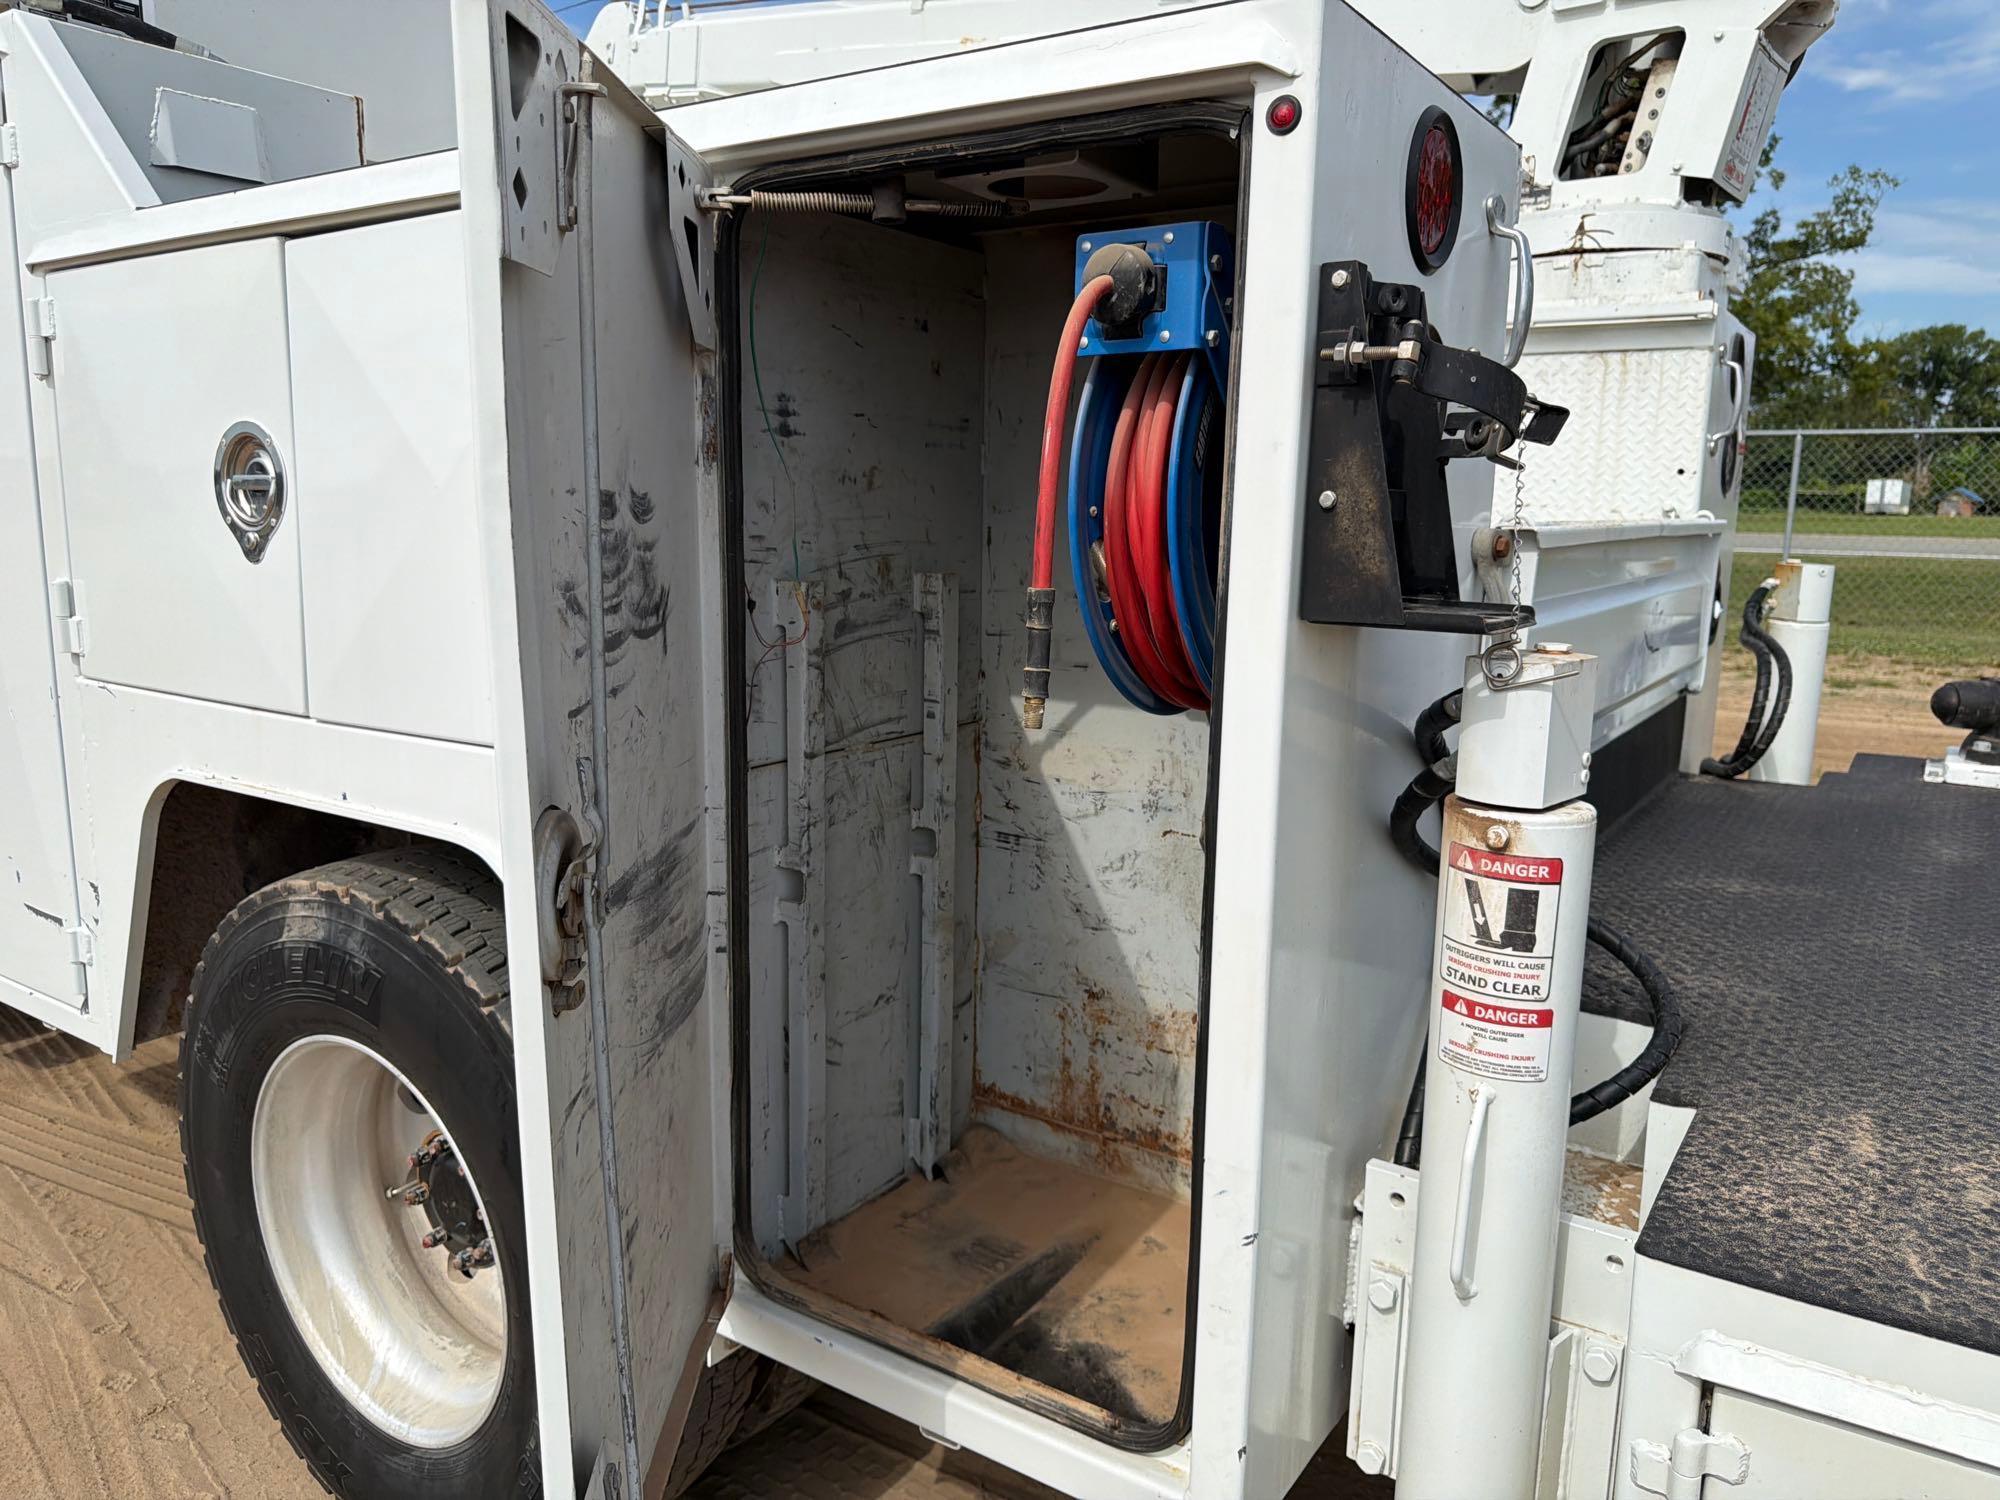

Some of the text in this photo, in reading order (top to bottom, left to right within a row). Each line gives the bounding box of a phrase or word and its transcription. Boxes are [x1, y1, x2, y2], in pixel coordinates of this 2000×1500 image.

[1480, 859, 1549, 878] DANGER
[1445, 943, 1545, 971] OUTRIGGERS WILL CAUSE
[1448, 955, 1472, 970] SERIOUS
[1473, 966, 1511, 978] CRUSHING
[1446, 966, 1541, 996] STAND CLEAR
[1475, 1006, 1538, 1025] DANGER
[1465, 1023, 1488, 1033] MOVING
[1489, 1029, 1525, 1038] OUTRIGGER
[1472, 1031, 1508, 1043] WILL CAUSE
[1448, 1039, 1473, 1053] SERIOUS
[1474, 1048, 1509, 1060] CRUSHING
